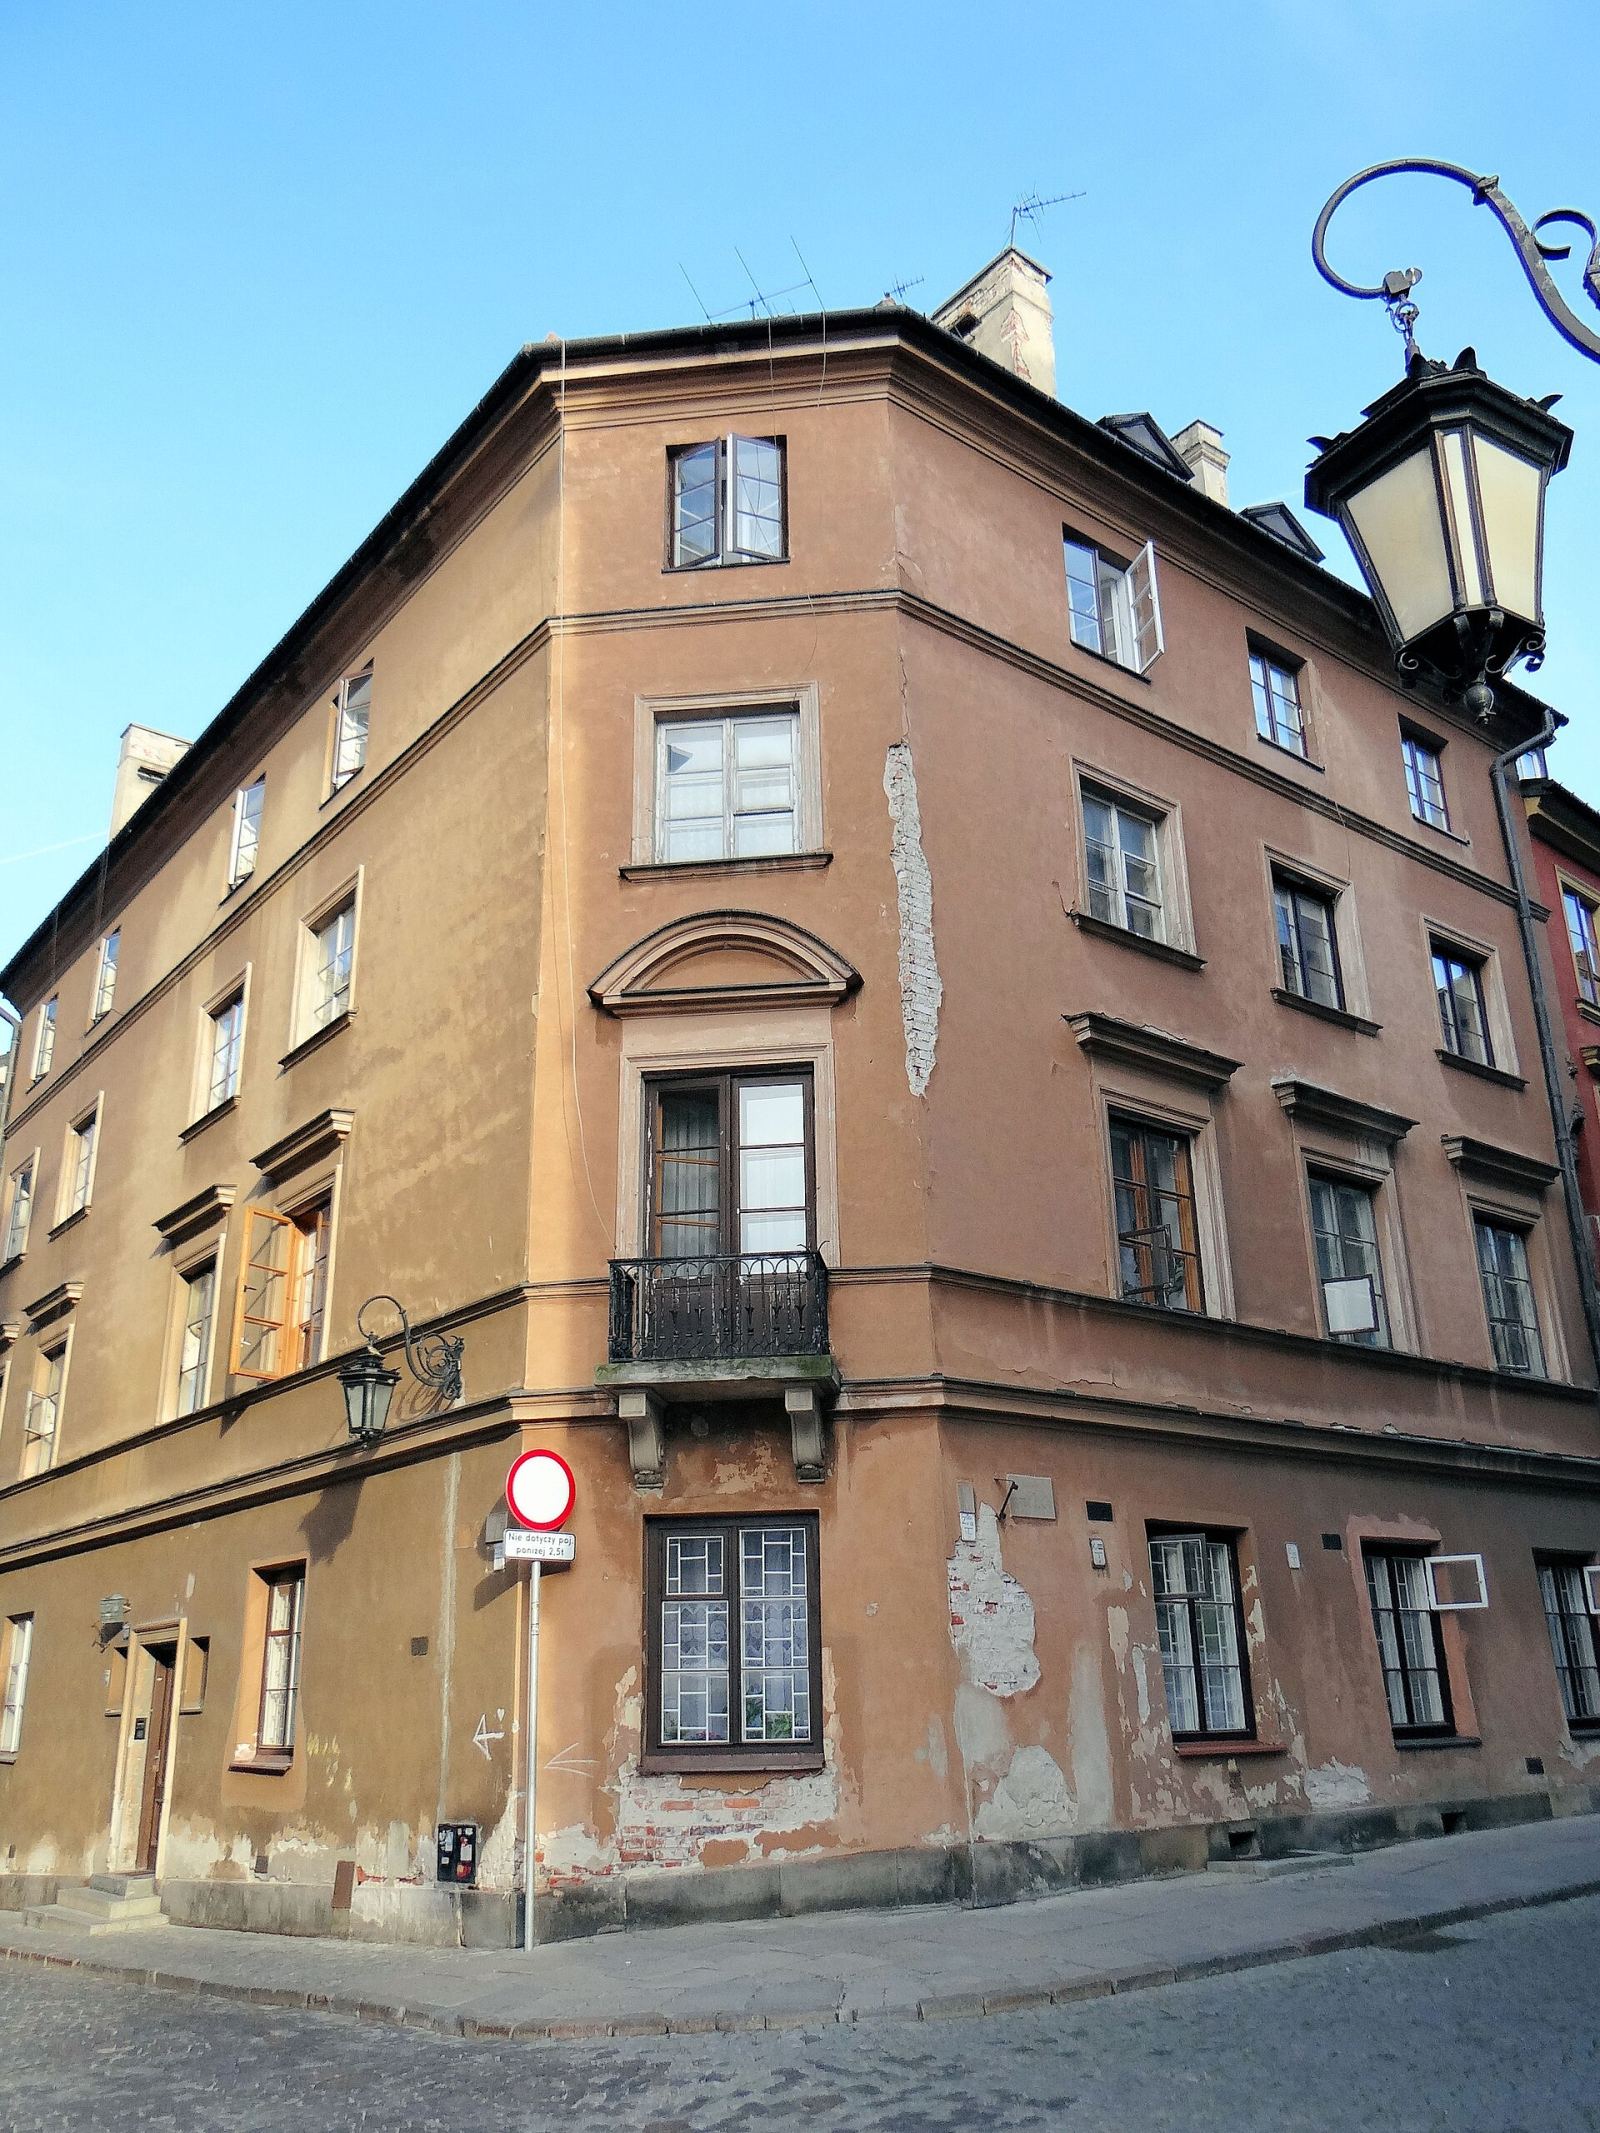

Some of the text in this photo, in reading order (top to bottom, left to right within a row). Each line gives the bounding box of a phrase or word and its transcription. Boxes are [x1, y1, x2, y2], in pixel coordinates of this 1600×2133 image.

[508, 1532, 523, 1542] Nie
[526, 1534, 556, 1546] dotyczy
[549, 1547, 564, 1556] 2,5t
